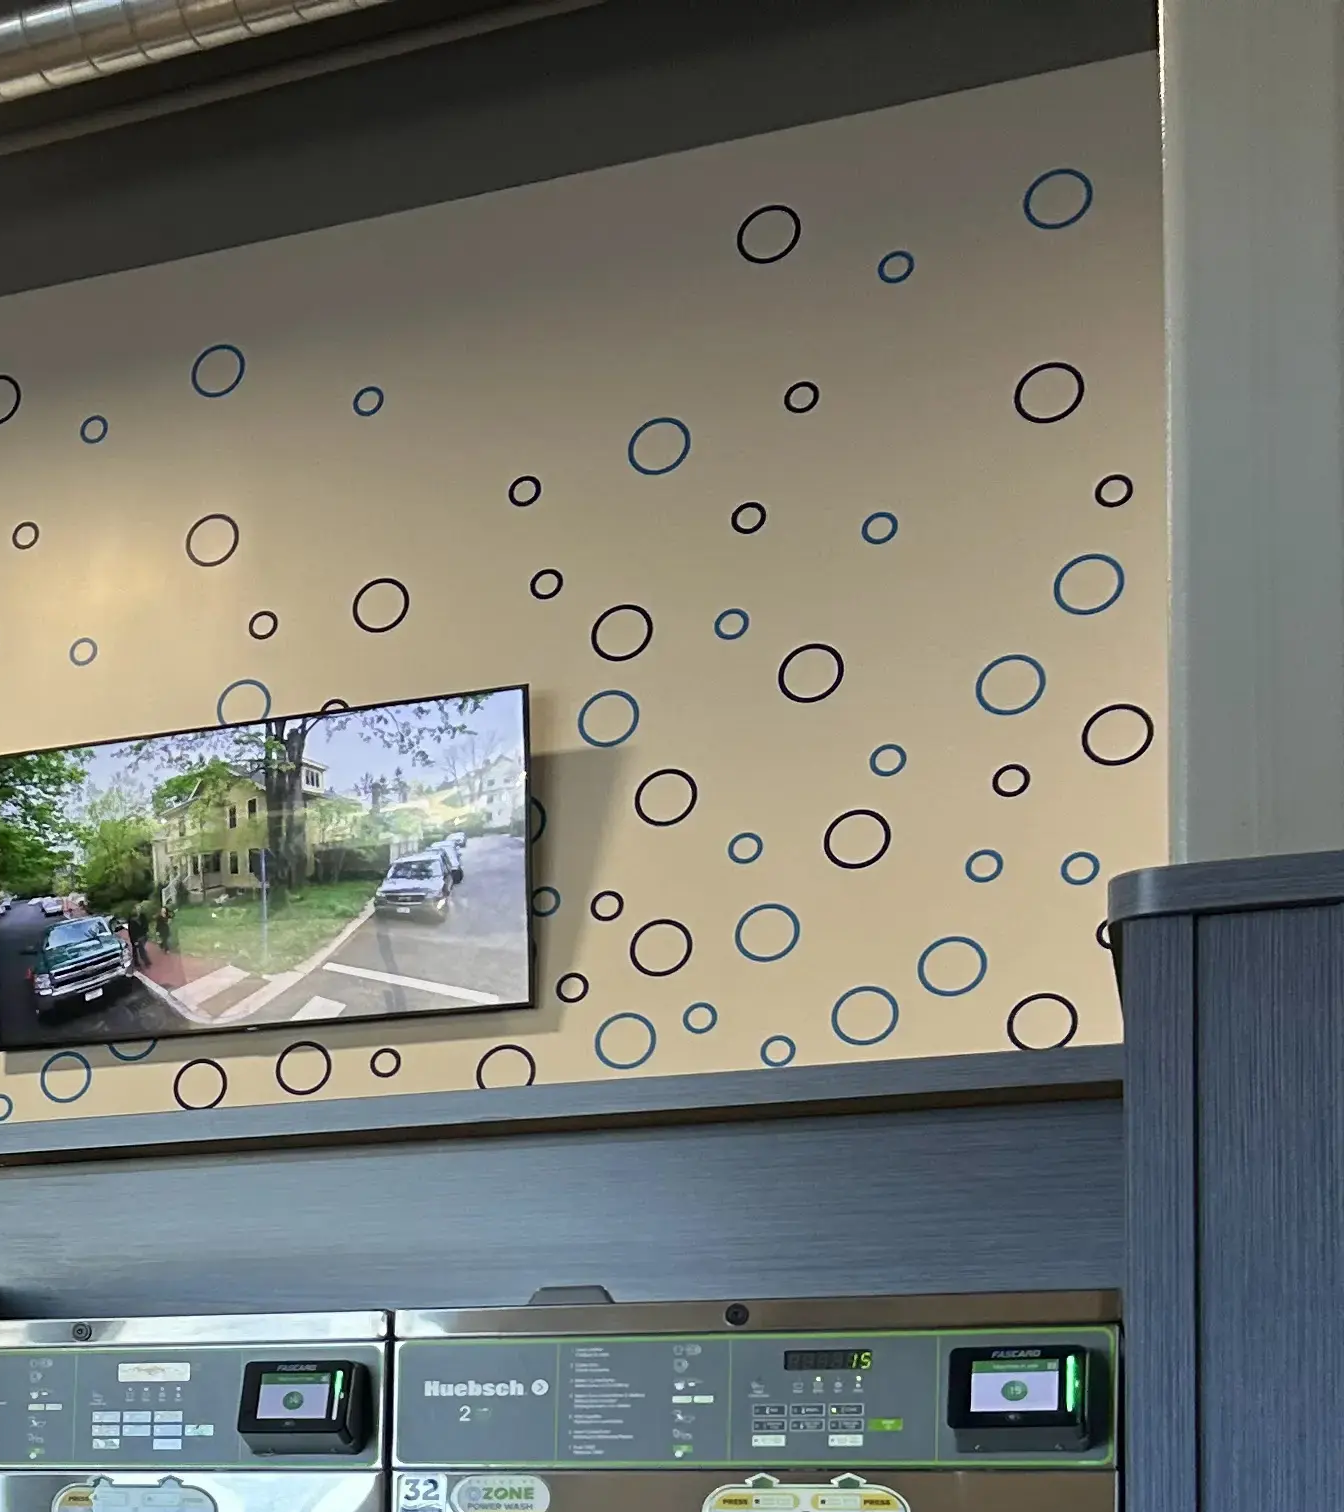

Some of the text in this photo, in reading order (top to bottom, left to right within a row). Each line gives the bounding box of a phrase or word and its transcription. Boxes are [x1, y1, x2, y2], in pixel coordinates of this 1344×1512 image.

[991, 1349, 1041, 1358] FASCARD
[424, 1379, 524, 1397] Huebsch
[459, 1405, 471, 1422] 2
[404, 1478, 440, 1501] 32
[467, 1503, 533, 1511] POWER WASH
[722, 1498, 748, 1506] PRESS
